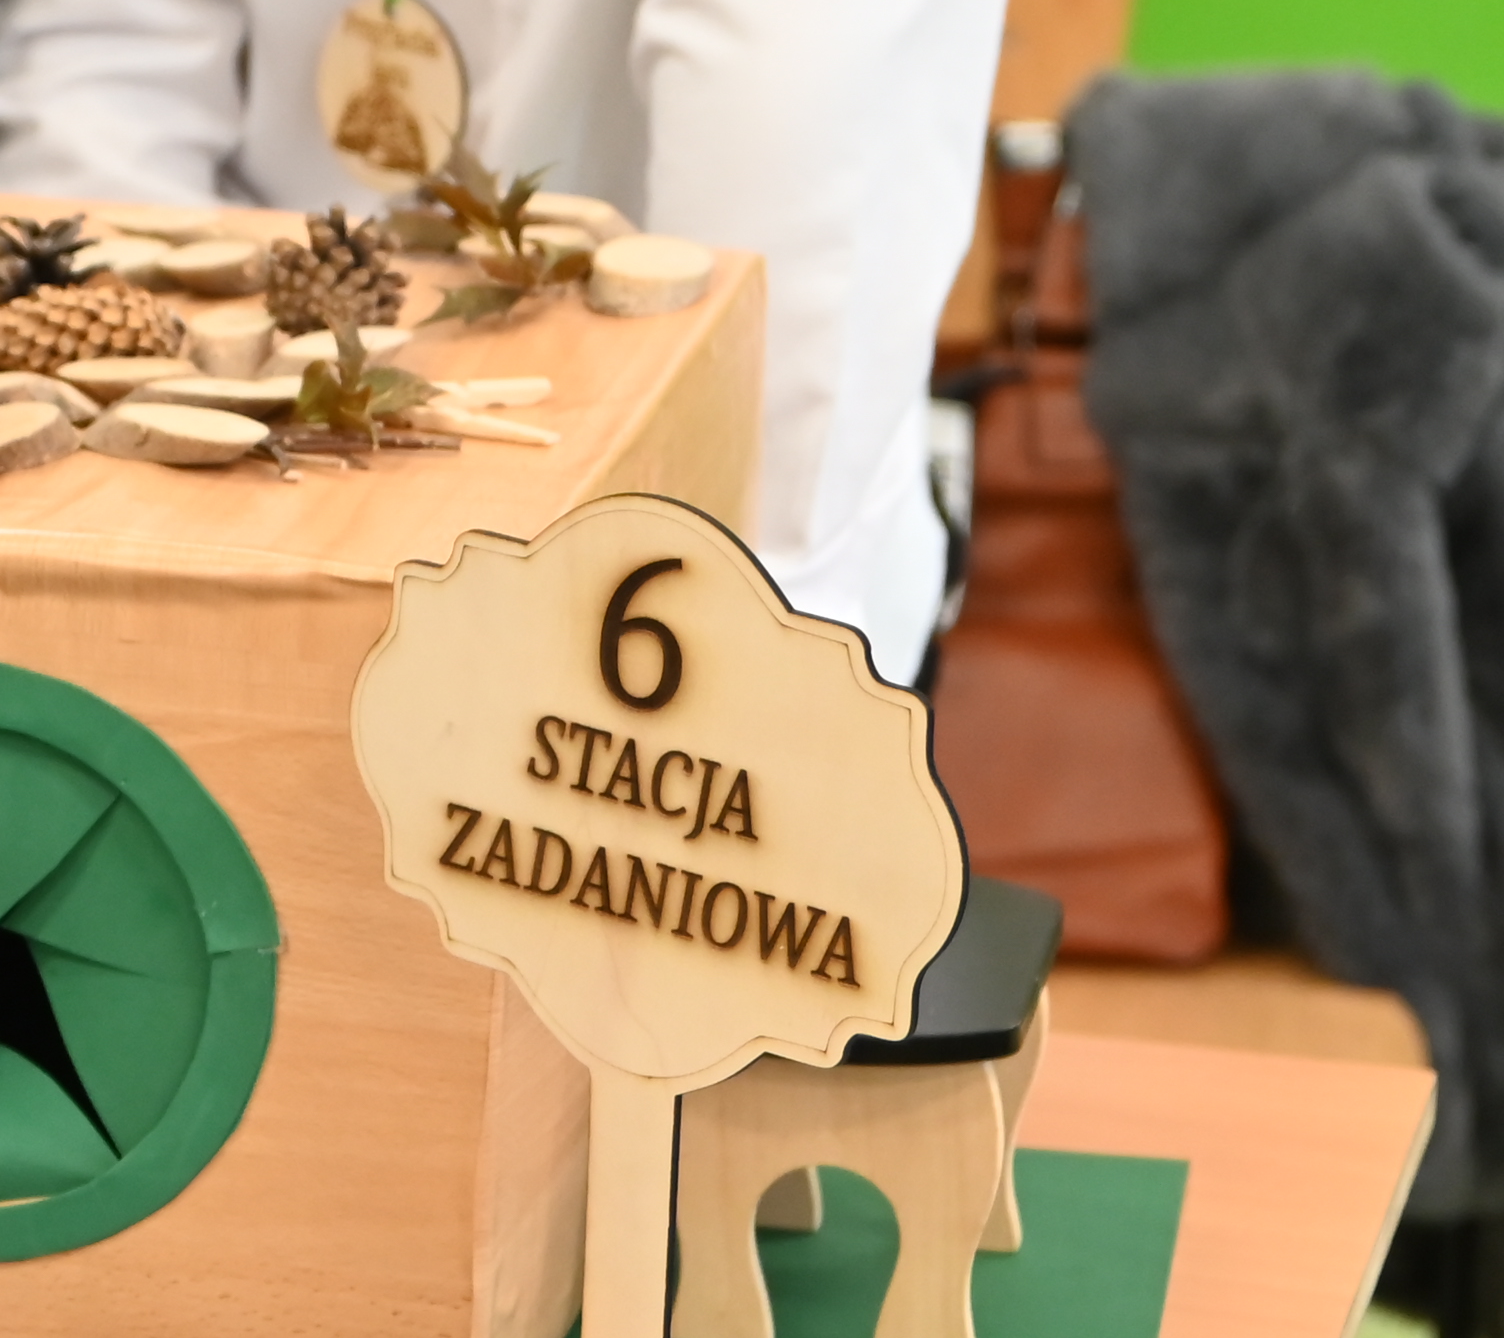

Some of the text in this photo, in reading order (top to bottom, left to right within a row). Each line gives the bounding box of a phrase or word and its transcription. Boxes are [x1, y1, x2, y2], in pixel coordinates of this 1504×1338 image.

[598, 557, 684, 712] 6
[526, 714, 759, 842] STACJA
[438, 802, 861, 990] ZADANIOWA
